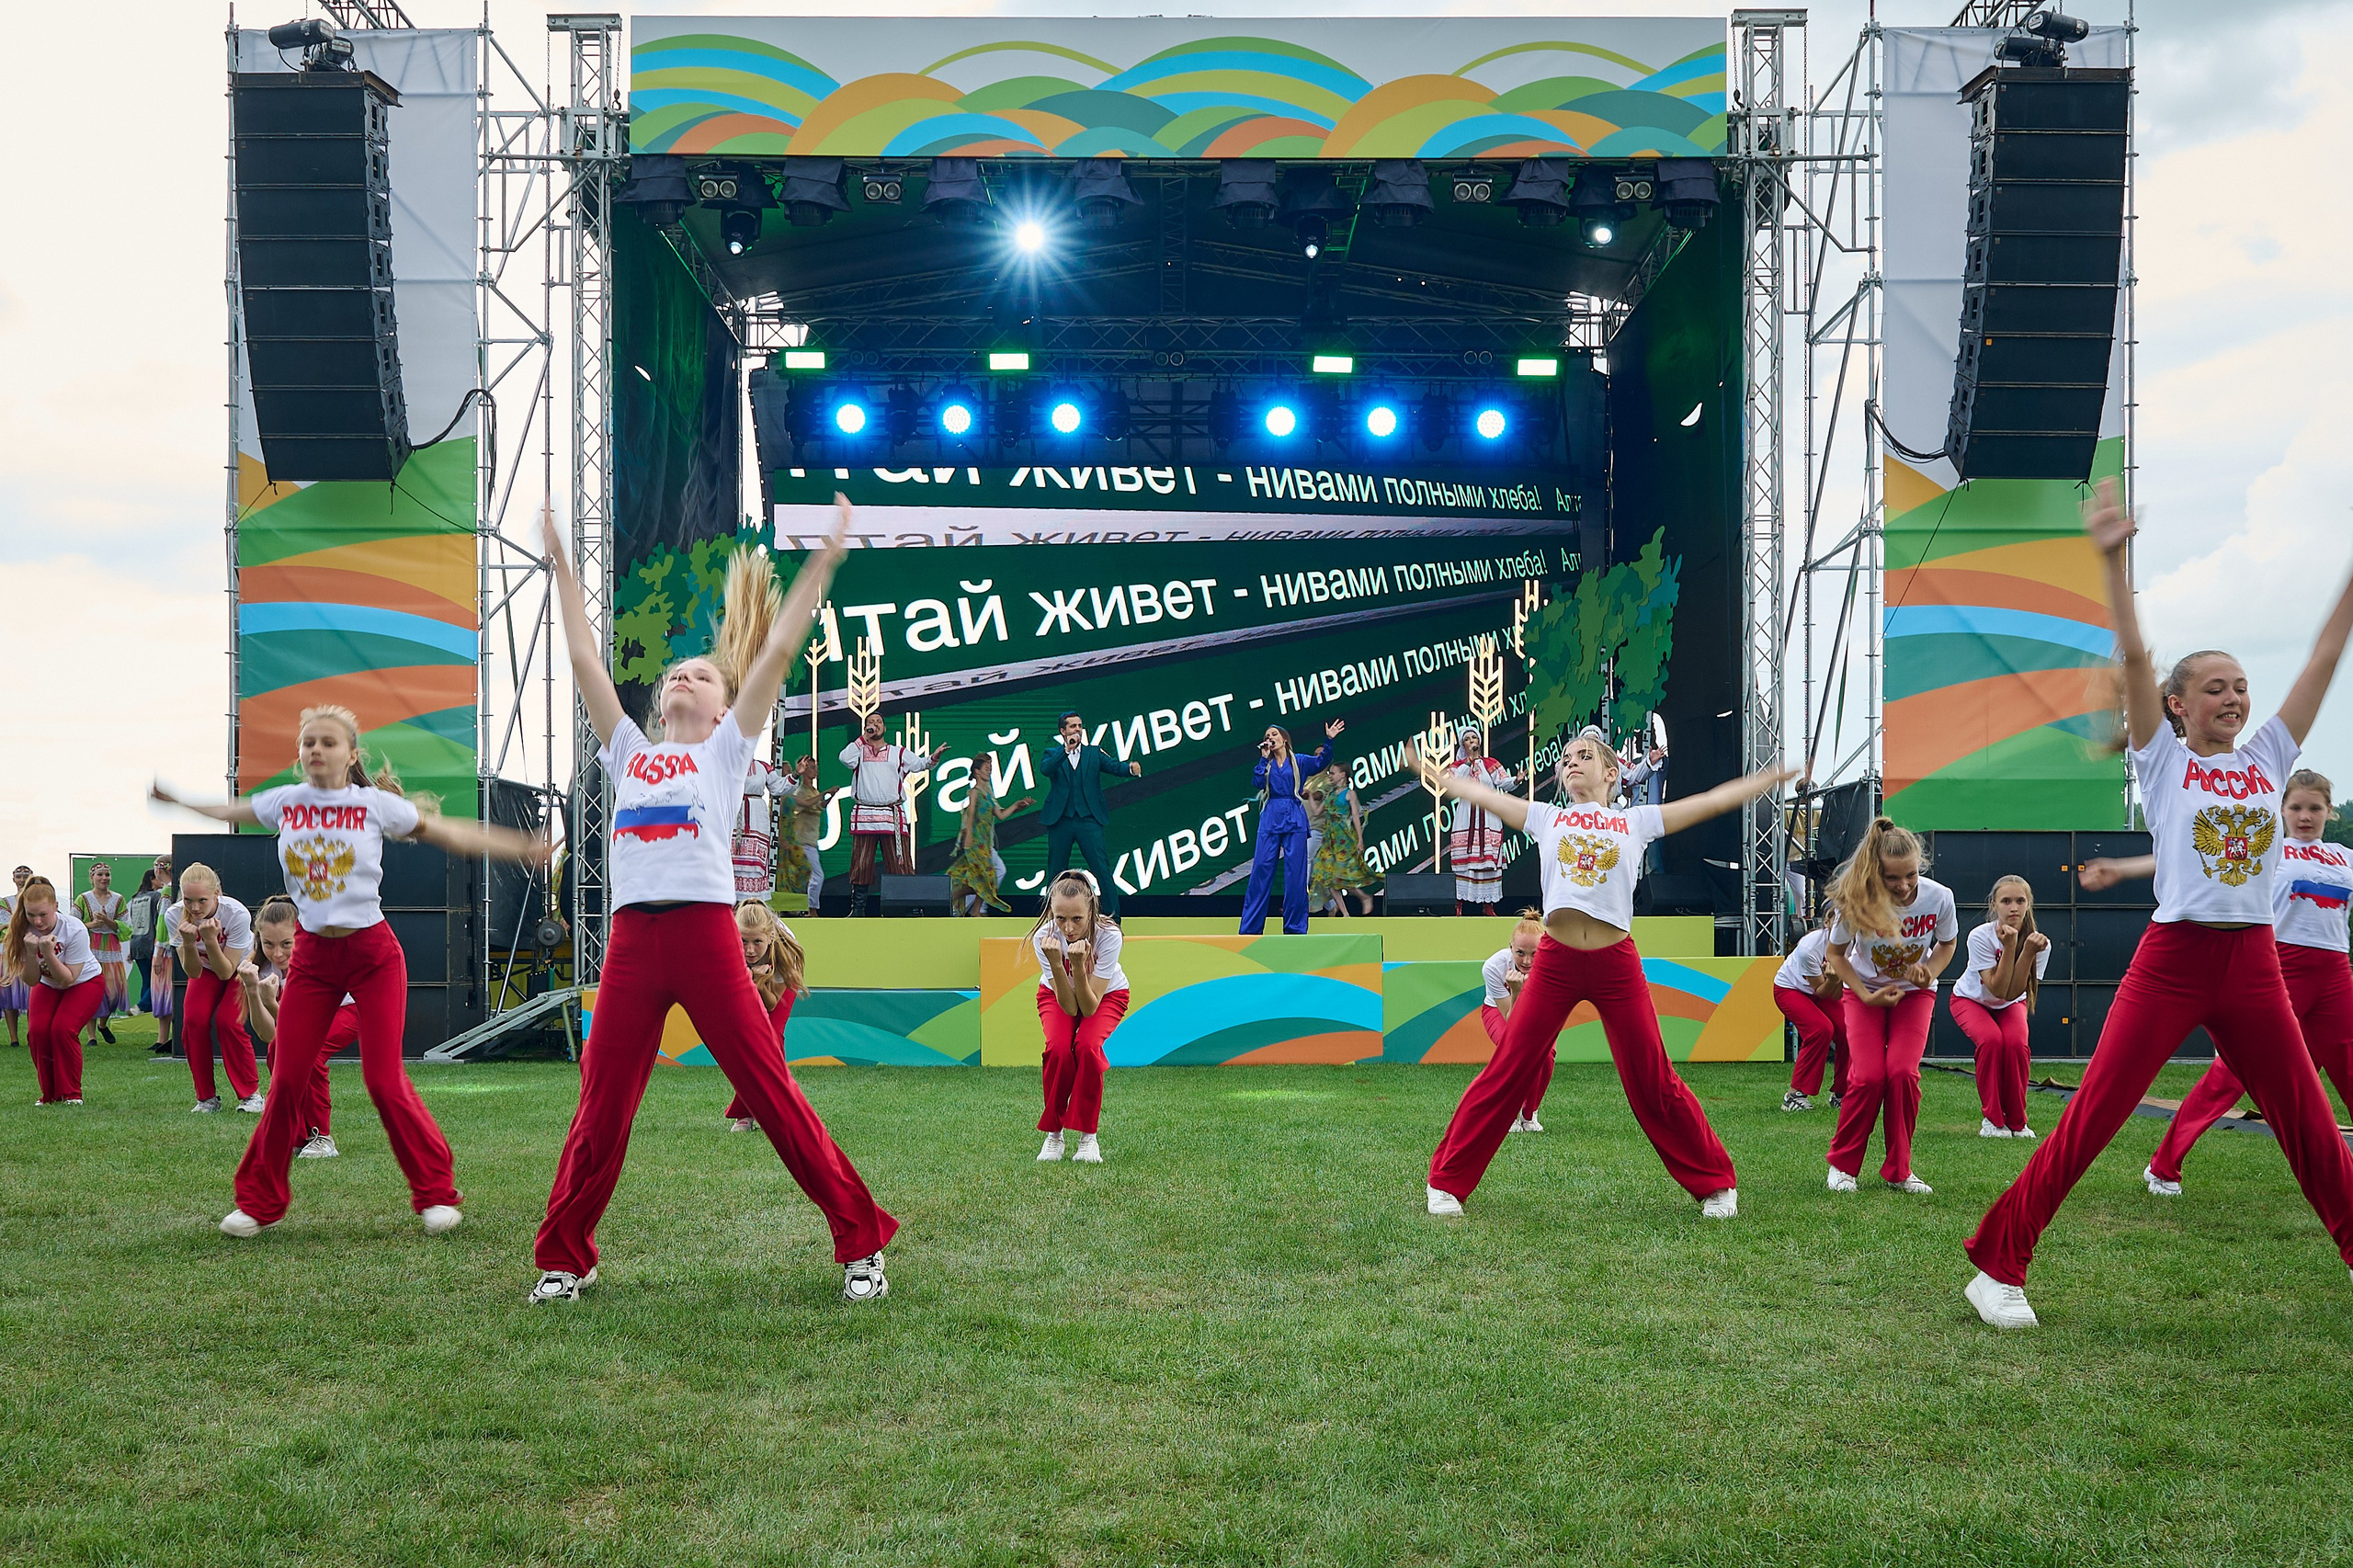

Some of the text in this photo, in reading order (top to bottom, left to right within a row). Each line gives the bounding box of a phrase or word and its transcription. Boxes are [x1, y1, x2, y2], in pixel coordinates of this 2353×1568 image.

[1245, 466, 1379, 504] нивами
[1383, 477, 1486, 508] полными
[1488, 484, 1542, 511] хлеба!
[1028, 578, 1218, 637] живет
[1260, 564, 1387, 608] нивами
[1392, 559, 1494, 593] полными
[1495, 549, 1549, 580] хлеба!
[1275, 654, 1399, 715] нивами
[281, 804, 368, 831] РОССИЯ
[1553, 811, 1629, 835] РОССИЯ
